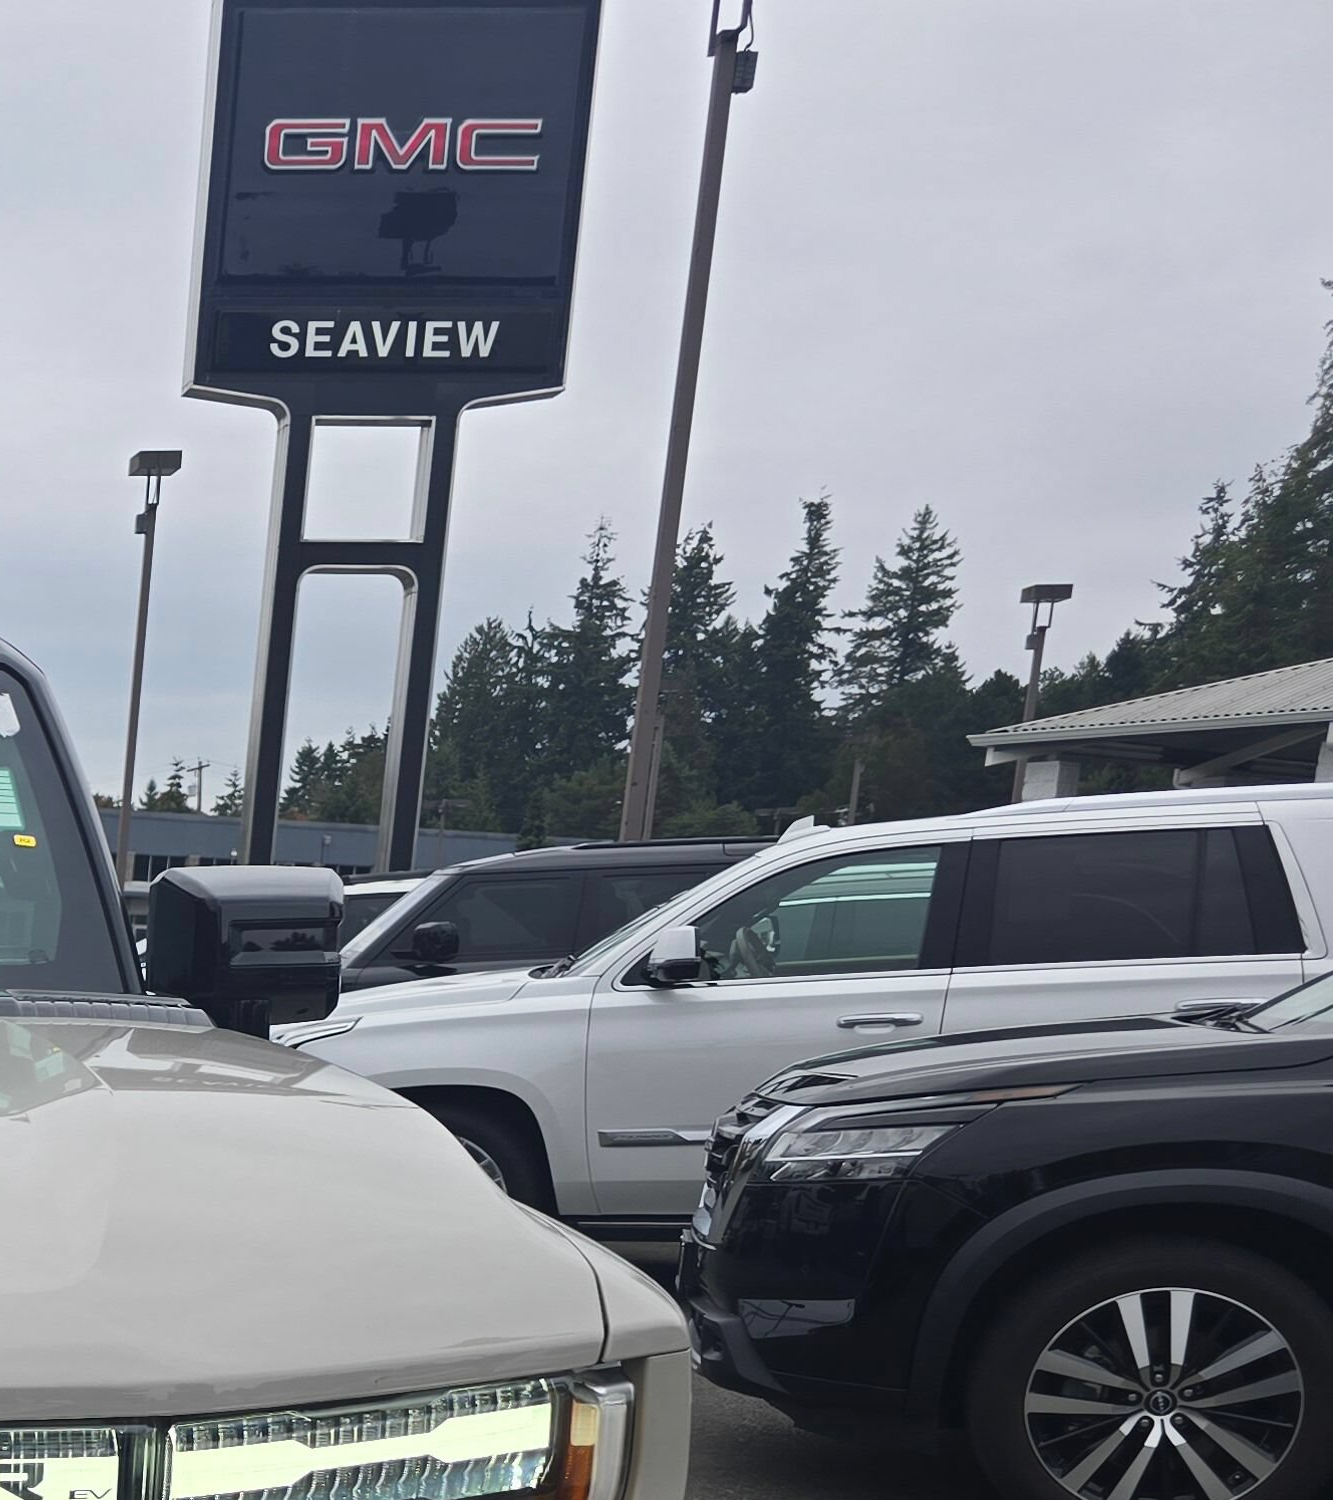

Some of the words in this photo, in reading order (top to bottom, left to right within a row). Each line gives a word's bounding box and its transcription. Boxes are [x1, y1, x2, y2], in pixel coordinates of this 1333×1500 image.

[264, 117, 543, 170] GMC
[269, 319, 500, 359] SEAVIEW
[68, 1488, 113, 1500] EV
